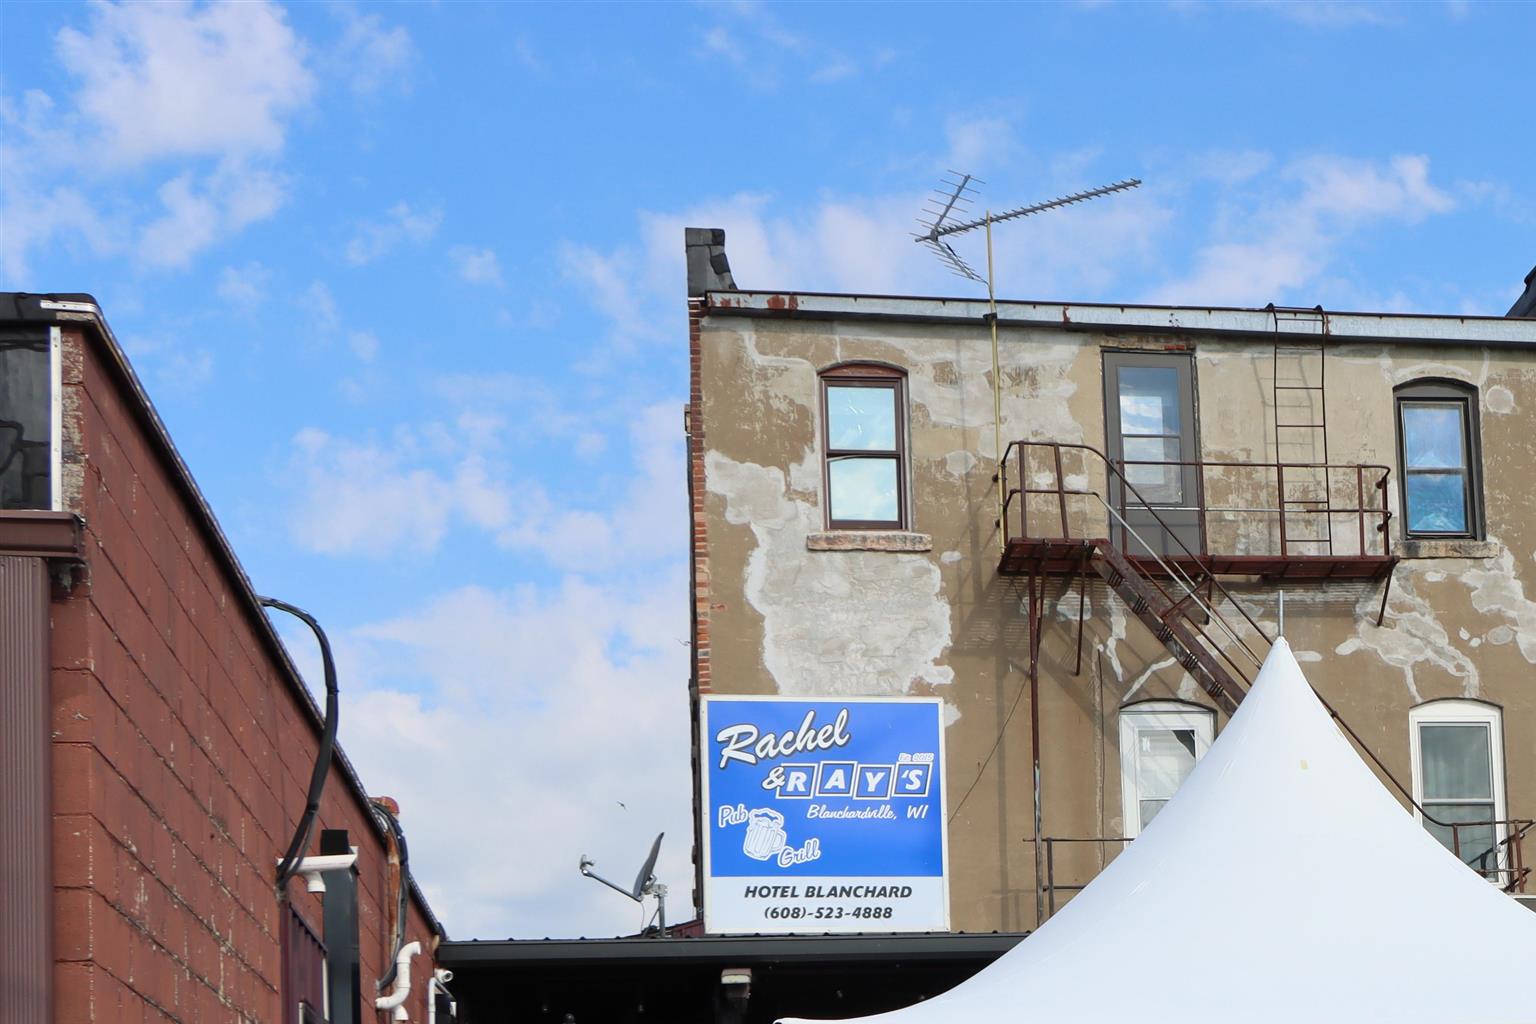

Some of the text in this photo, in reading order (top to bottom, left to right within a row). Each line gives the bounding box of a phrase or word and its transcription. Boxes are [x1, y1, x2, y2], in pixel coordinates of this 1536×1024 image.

[716, 708, 850, 769] Rachel
[762, 766, 786, 790] &
[718, 803, 749, 828] Pub
[806, 804, 929, 821] Blanchardville, WI
[777, 838, 821, 868] Grill
[744, 886, 913, 899] HOTEL BLANCHARD
[764, 906, 893, 920] (608)-523-4888
